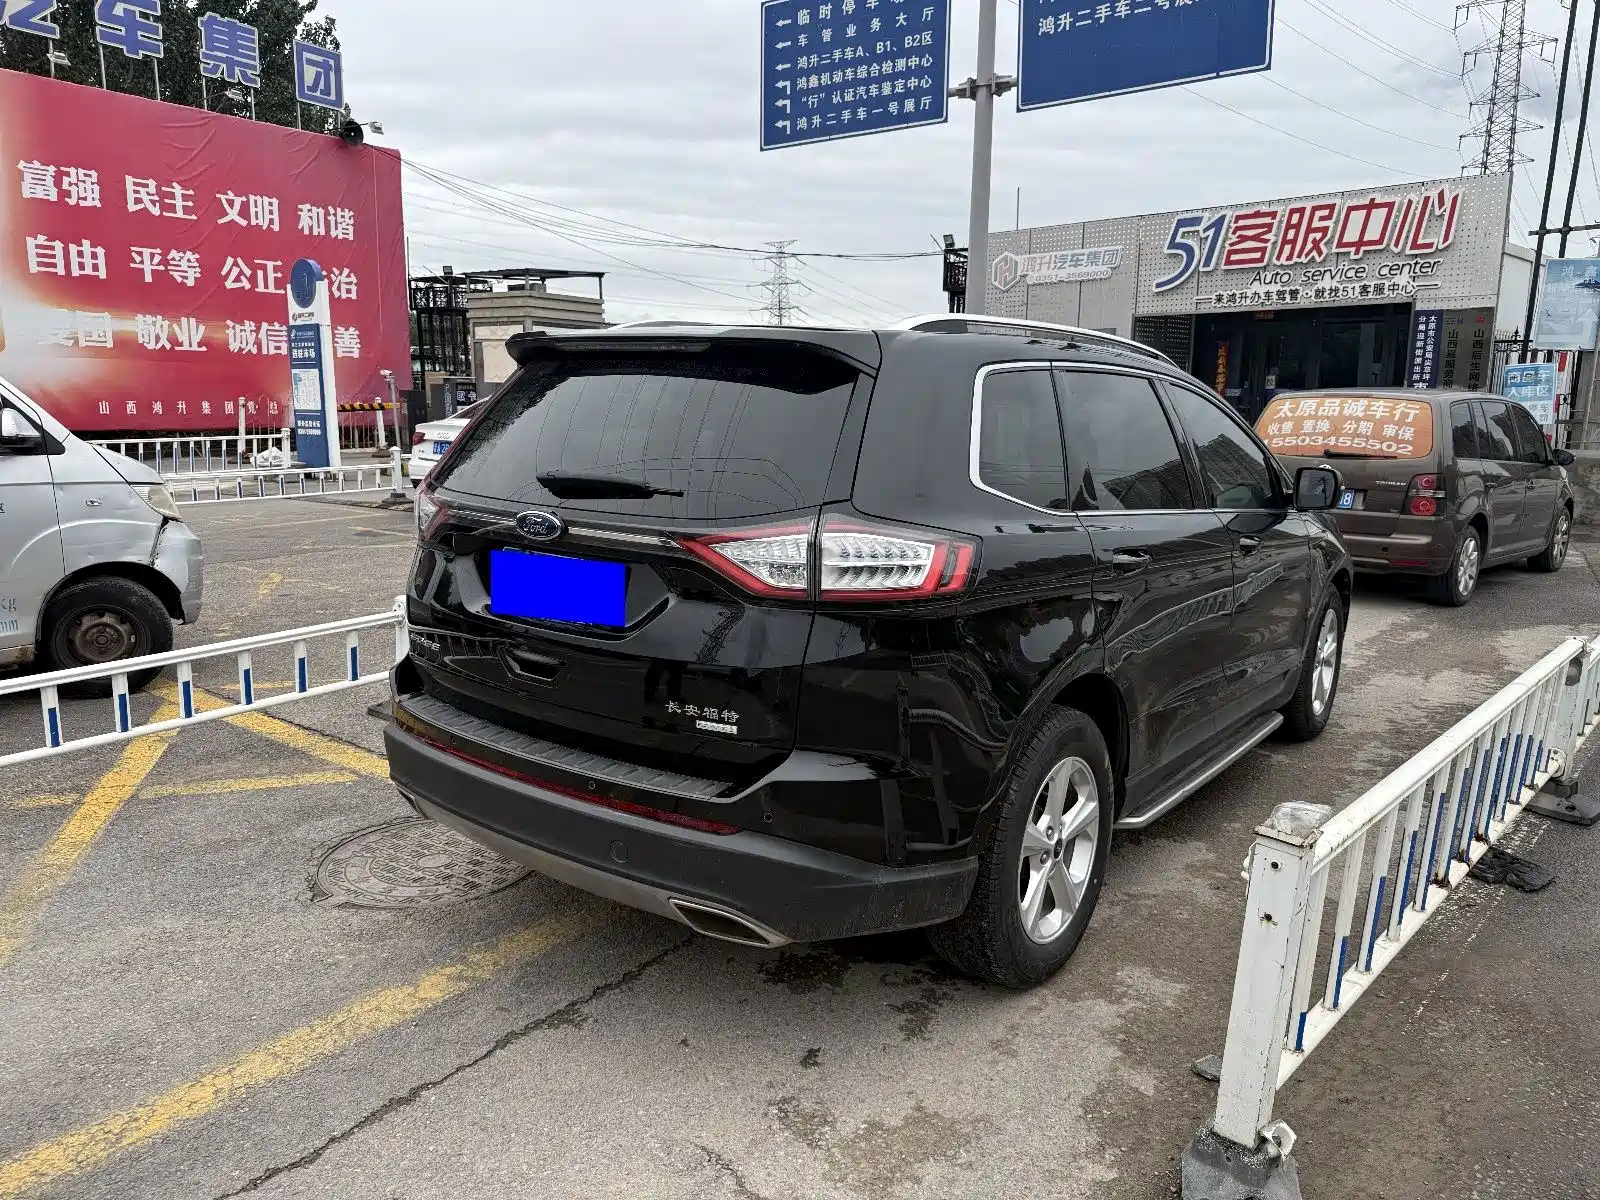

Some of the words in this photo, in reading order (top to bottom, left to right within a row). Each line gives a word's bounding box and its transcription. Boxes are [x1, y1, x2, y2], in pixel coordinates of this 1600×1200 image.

[797, 0, 905, 26] 临时停车
[797, 6, 934, 47] 车管业务大厅
[1038, 0, 1200, 35] 鸿升二手车二号
[796, 54, 933, 91] 鸿鑫机动车综合检测中心
[796, 96, 932, 131] 鸿升二手车一号展厅
[16, 159, 102, 207] 富强
[124, 174, 197, 221] 民主
[215, 191, 280, 231] 文明
[297, 203, 355, 241] 和谐
[1153, 186, 1461, 291] 51客服中心
[26, 235, 107, 279] 自由
[130, 246, 201, 286] 平等
[220, 256, 286, 296] 公正
[322, 266, 358, 299] 治
[1022, 248, 1120, 272] 鸿升汽车集团
[1249, 269, 1293, 286] Auto
[1301, 262, 1366, 282] service
[1377, 257, 1442, 277] center
[134, 314, 207, 353] 敬业
[226, 319, 288, 356] 诚信
[334, 326, 361, 358] 善
[1273, 399, 1420, 423] 太原品诚车行
[1267, 419, 1295, 436] 收售
[1300, 419, 1331, 433] 置换
[1341, 419, 1375, 436] 分期
[1382, 424, 1416, 441] 审保
[521, 515, 549, 535] Ford
[665, 700, 740, 723] 长安福特
